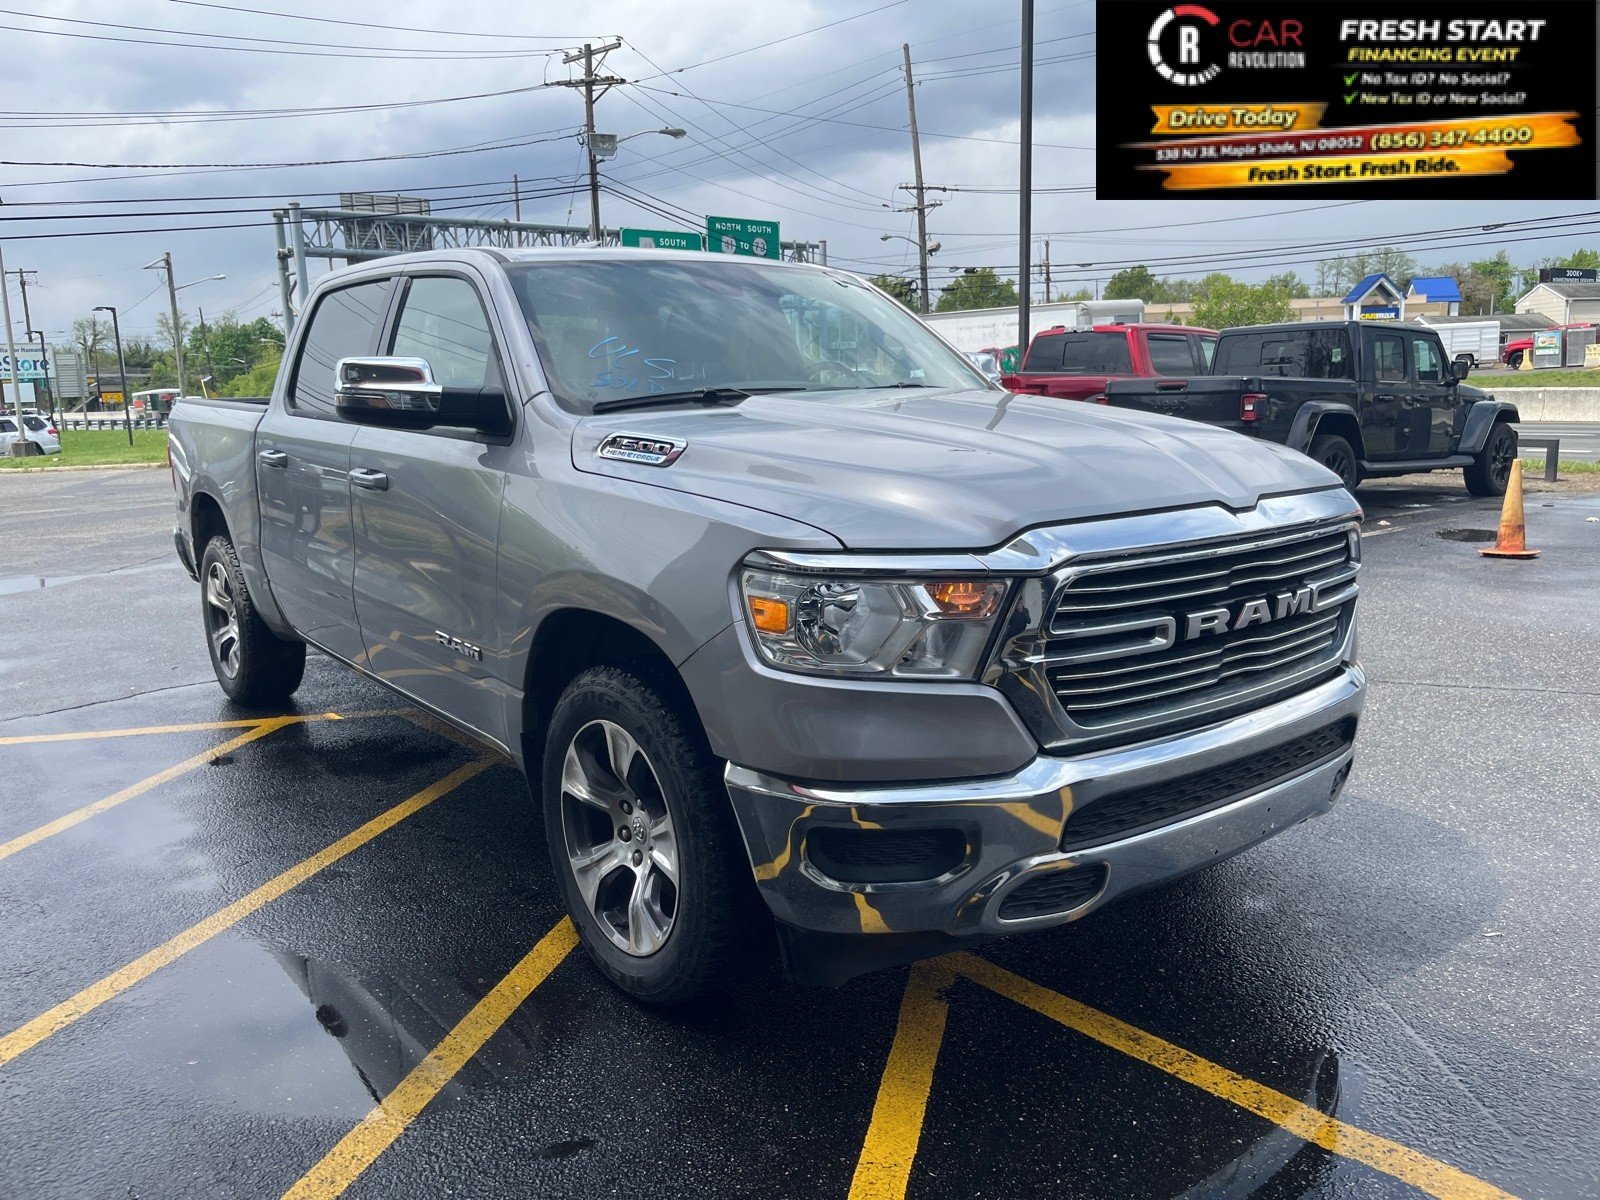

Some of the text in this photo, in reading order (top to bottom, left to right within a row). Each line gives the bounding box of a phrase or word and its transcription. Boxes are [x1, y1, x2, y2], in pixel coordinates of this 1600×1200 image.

[715, 222, 772, 234] NORTH SOUTH
[659, 238, 687, 247] SOUTH
[740, 241, 750, 250] TO
[754, 241, 766, 253] 73
[607, 437, 672, 455] 1500
[605, 448, 627, 457] HEMI
[1184, 586, 1312, 641] RAM
[435, 630, 482, 661] RAM
